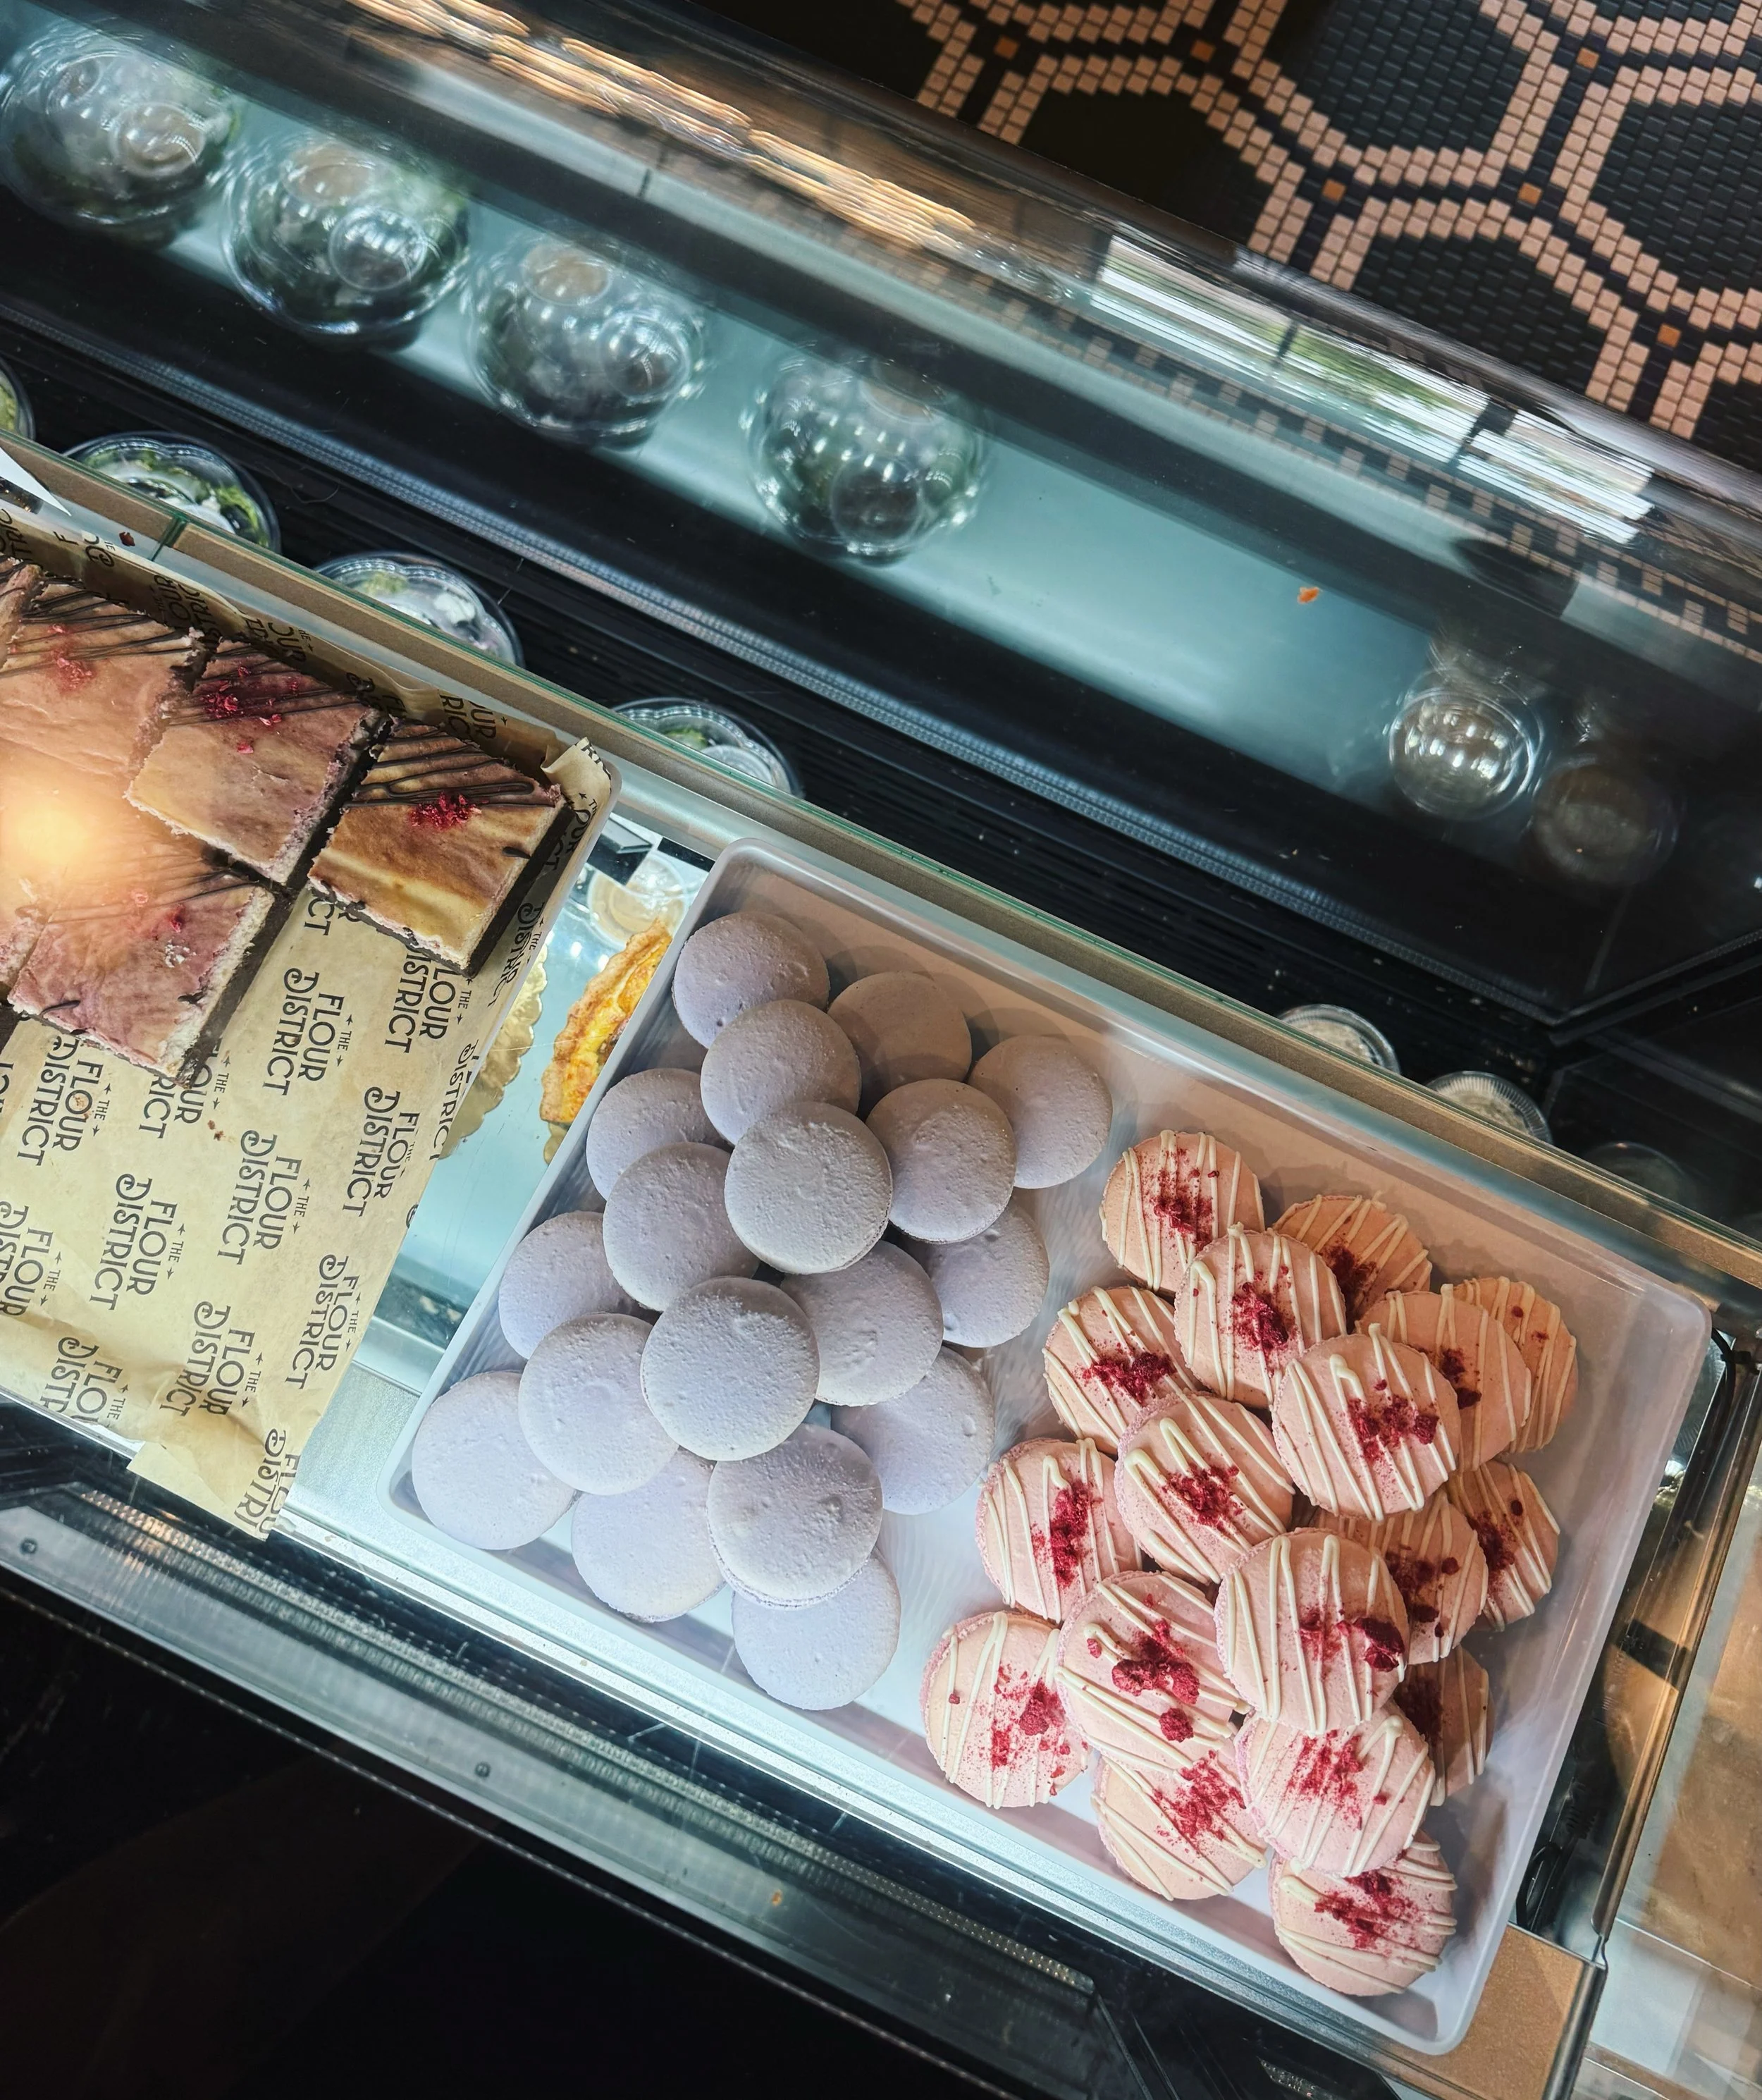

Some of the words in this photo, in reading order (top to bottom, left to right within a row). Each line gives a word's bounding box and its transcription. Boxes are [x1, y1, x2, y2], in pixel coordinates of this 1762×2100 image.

[529, 931, 542, 950] THE
[262, 967, 320, 1096] DISTRICT
[297, 993, 345, 1081] FLOUR
[337, 1031, 352, 1051] THE
[383, 945, 432, 1054] ISTRICT
[418, 966, 462, 1040] LOUR
[457, 990, 472, 1009] THE
[16, 1036, 80, 1166] DISTRICT
[52, 1060, 104, 1151] FLOUR
[94, 1100, 110, 1121] THE
[138, 1073, 177, 1139] RICT
[214, 1072, 230, 1093] THE
[342, 1086, 401, 1217] DISTRICT
[373, 1112, 421, 1199] FLOUR
[406, 1141, 416, 1162] THE
[217, 1129, 278, 1265] DISTRICT
[252, 1155, 302, 1250] FLOUR
[293, 1196, 309, 1217] THE
[0, 1228, 54, 1316] FLOUR
[43, 1269, 61, 1291] THE
[89, 1173, 153, 1310] DISTRICT
[125, 1199, 178, 1296] FLOUR
[168, 1241, 185, 1263] THE
[159, 1301, 231, 1417] DISTRICT
[285, 1253, 350, 1390] DISTRICT
[315, 1275, 361, 1372] FLOUR
[347, 1310, 359, 1334] THE
[39, 1336, 99, 1413] DISTR
[70, 1360, 124, 1425] FLO
[106, 1397, 126, 1420] THE
[198, 1328, 255, 1416] FLOUR
[245, 1370, 262, 1394] THE
[233, 1428, 287, 1534] DISTRI
